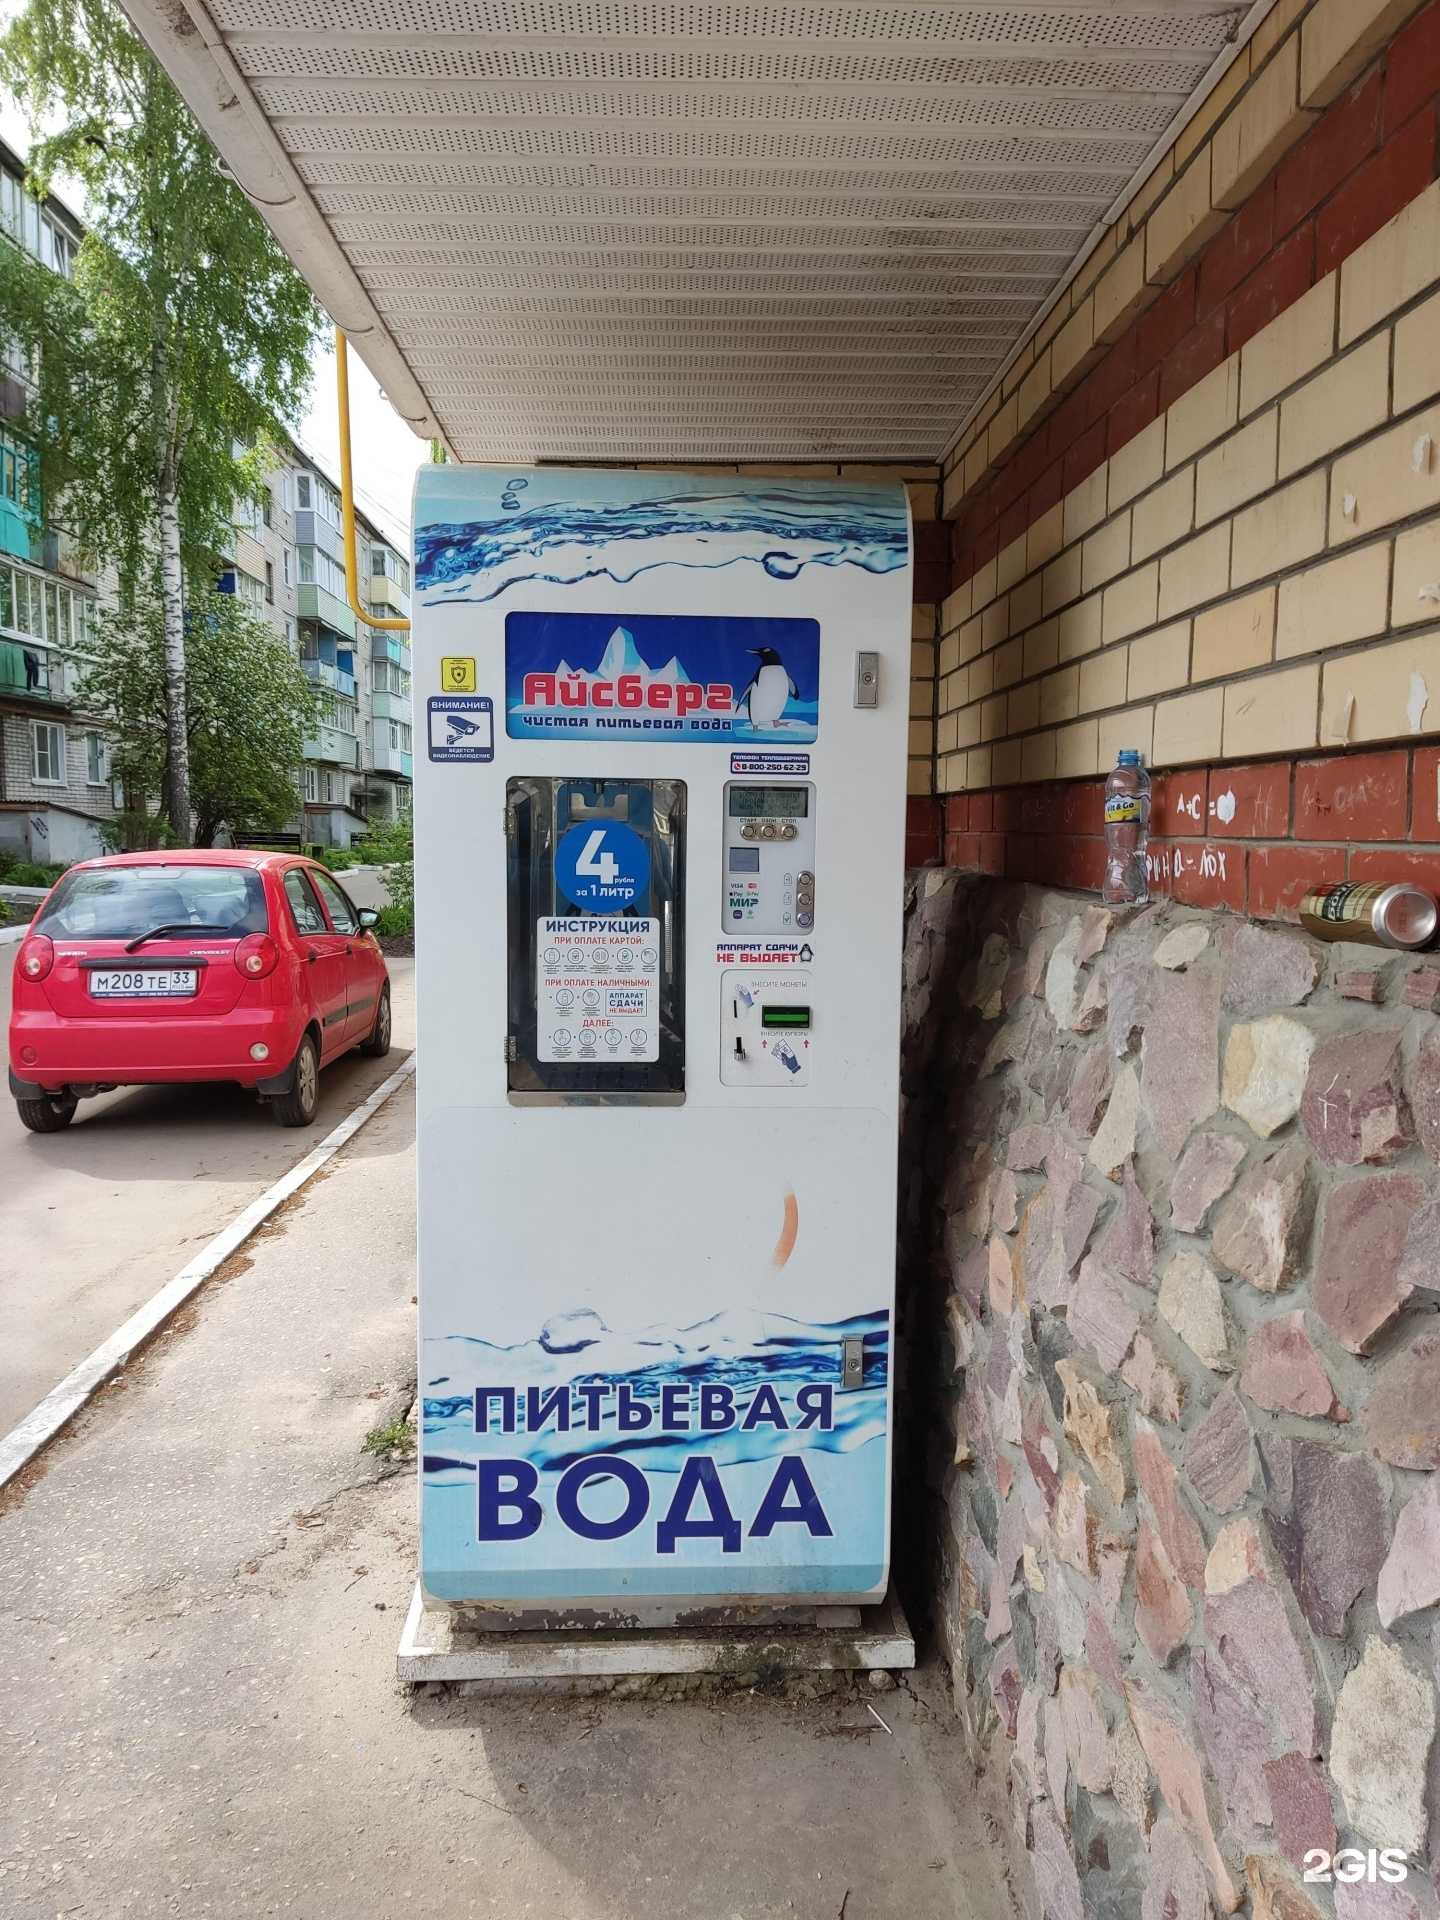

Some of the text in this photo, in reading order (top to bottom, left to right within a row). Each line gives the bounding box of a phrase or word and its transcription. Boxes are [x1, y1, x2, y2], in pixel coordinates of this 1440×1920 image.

[524, 674, 732, 716] Айсберг
[431, 701, 490, 709] ВНИМАНИЕ!
[523, 715, 733, 731] чистая питьевая вода
[741, 763, 807, 771] 8-800-250-62-29
[575, 830, 619, 884] 4
[589, 884, 597, 896] 1
[600, 886, 635, 899] литр
[729, 898, 760, 907] МИР
[546, 920, 650, 934] ИНСТРУКЦИЯ
[609, 935, 645, 945] КАРТОЙ:
[717, 953, 799, 962] НЕ ВЫДАЕТ
[173, 971, 190, 984] 33
[583, 1020, 614, 1028] ДАЛЕЕ:
[474, 1385, 834, 1432] ПИТЬЕВАЯ
[478, 1455, 834, 1554] ВОДА
